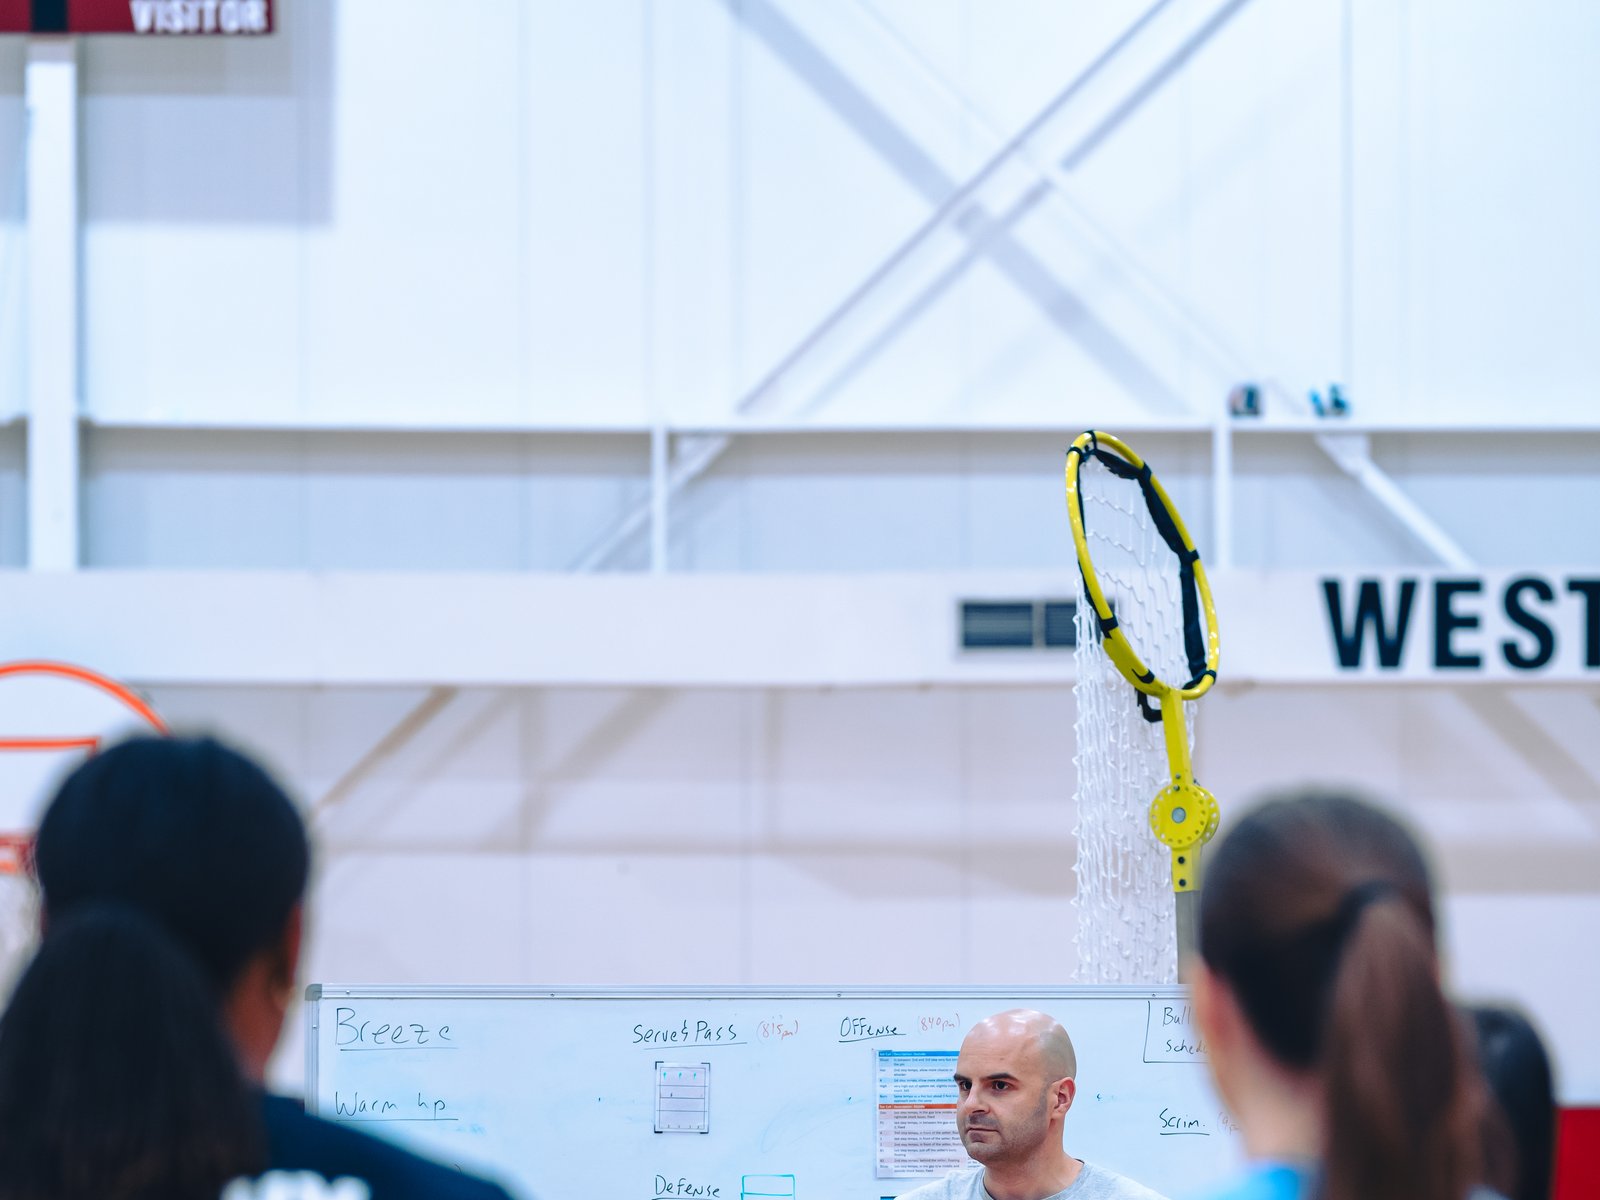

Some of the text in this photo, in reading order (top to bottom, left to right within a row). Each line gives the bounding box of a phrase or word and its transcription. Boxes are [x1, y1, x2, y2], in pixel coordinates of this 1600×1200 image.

[129, 0, 270, 33] VISITOR
[1322, 579, 1600, 667] WEST
[335, 1007, 452, 1046] Breeze
[695, 1020, 738, 1042] Pass
[335, 1091, 398, 1117] Warm
